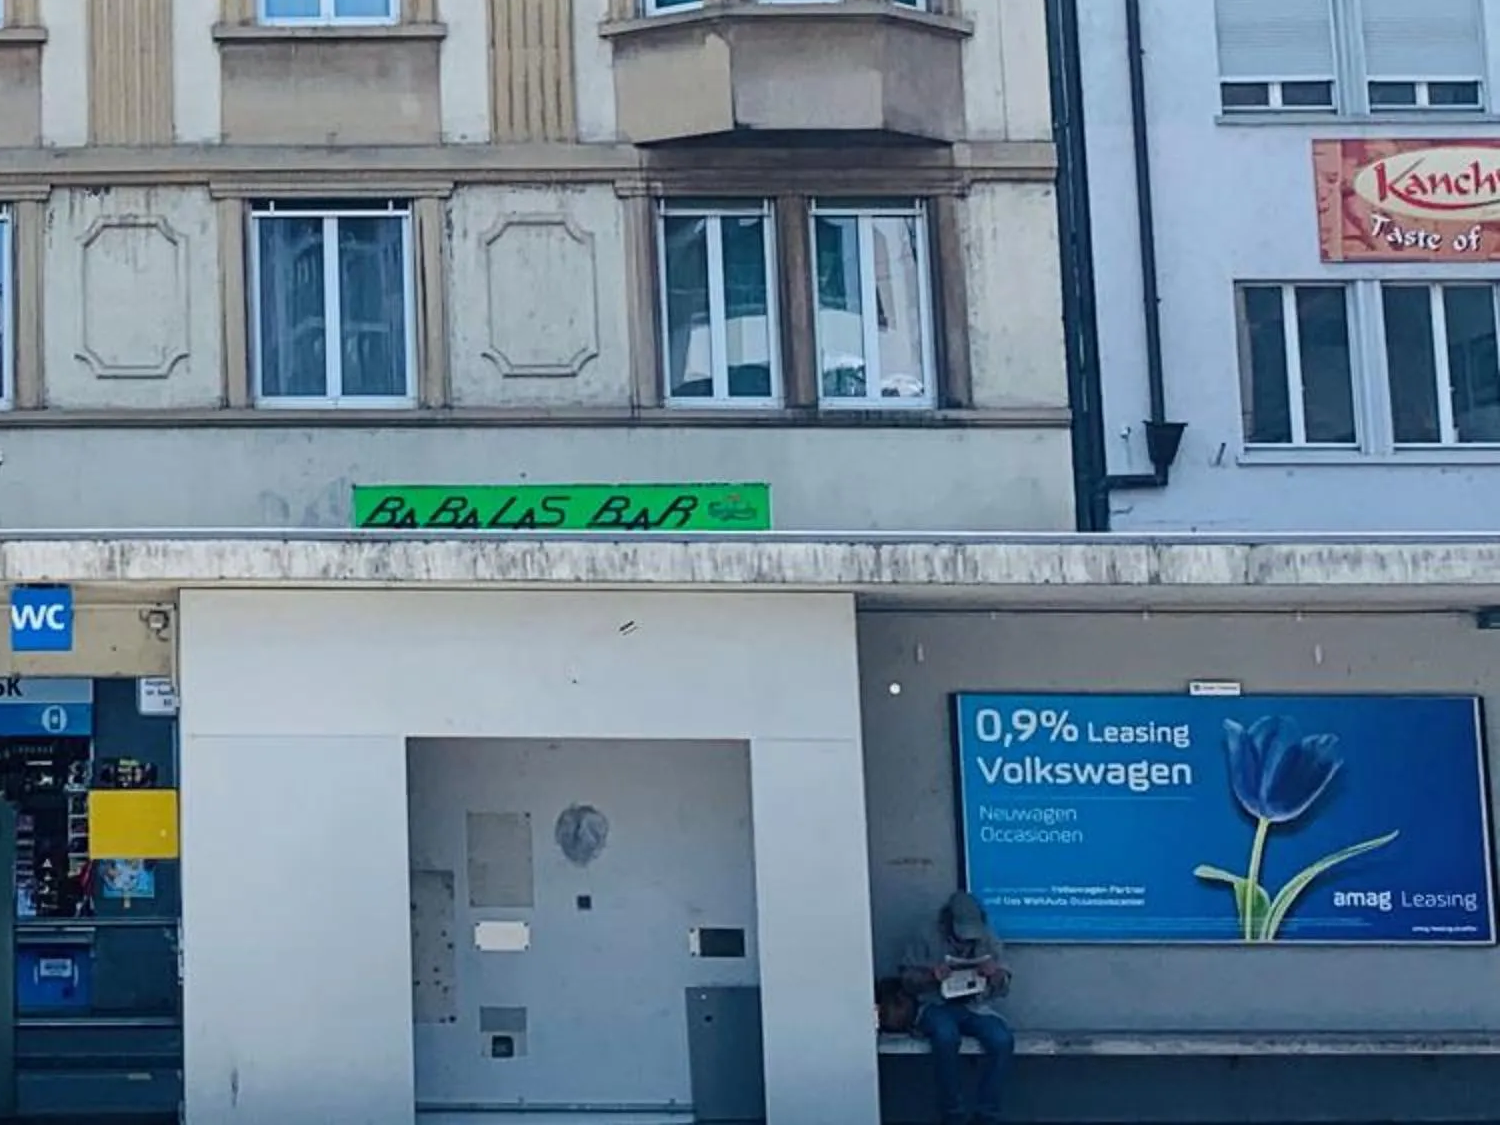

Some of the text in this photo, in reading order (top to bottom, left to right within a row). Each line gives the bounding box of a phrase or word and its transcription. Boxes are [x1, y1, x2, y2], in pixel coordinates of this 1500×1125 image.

[1374, 158, 1500, 210] Kanch
[1371, 213, 1481, 251] Taste of
[585, 495, 699, 530] BAR
[11, 604, 65, 631] WC
[976, 708, 1190, 748] 0,9% Leasing
[977, 755, 1193, 792] Volkswagen
[979, 804, 1077, 825] Neuwagen
[980, 826, 1083, 843] Occasionen
[1333, 890, 1477, 912] amag Leasing
